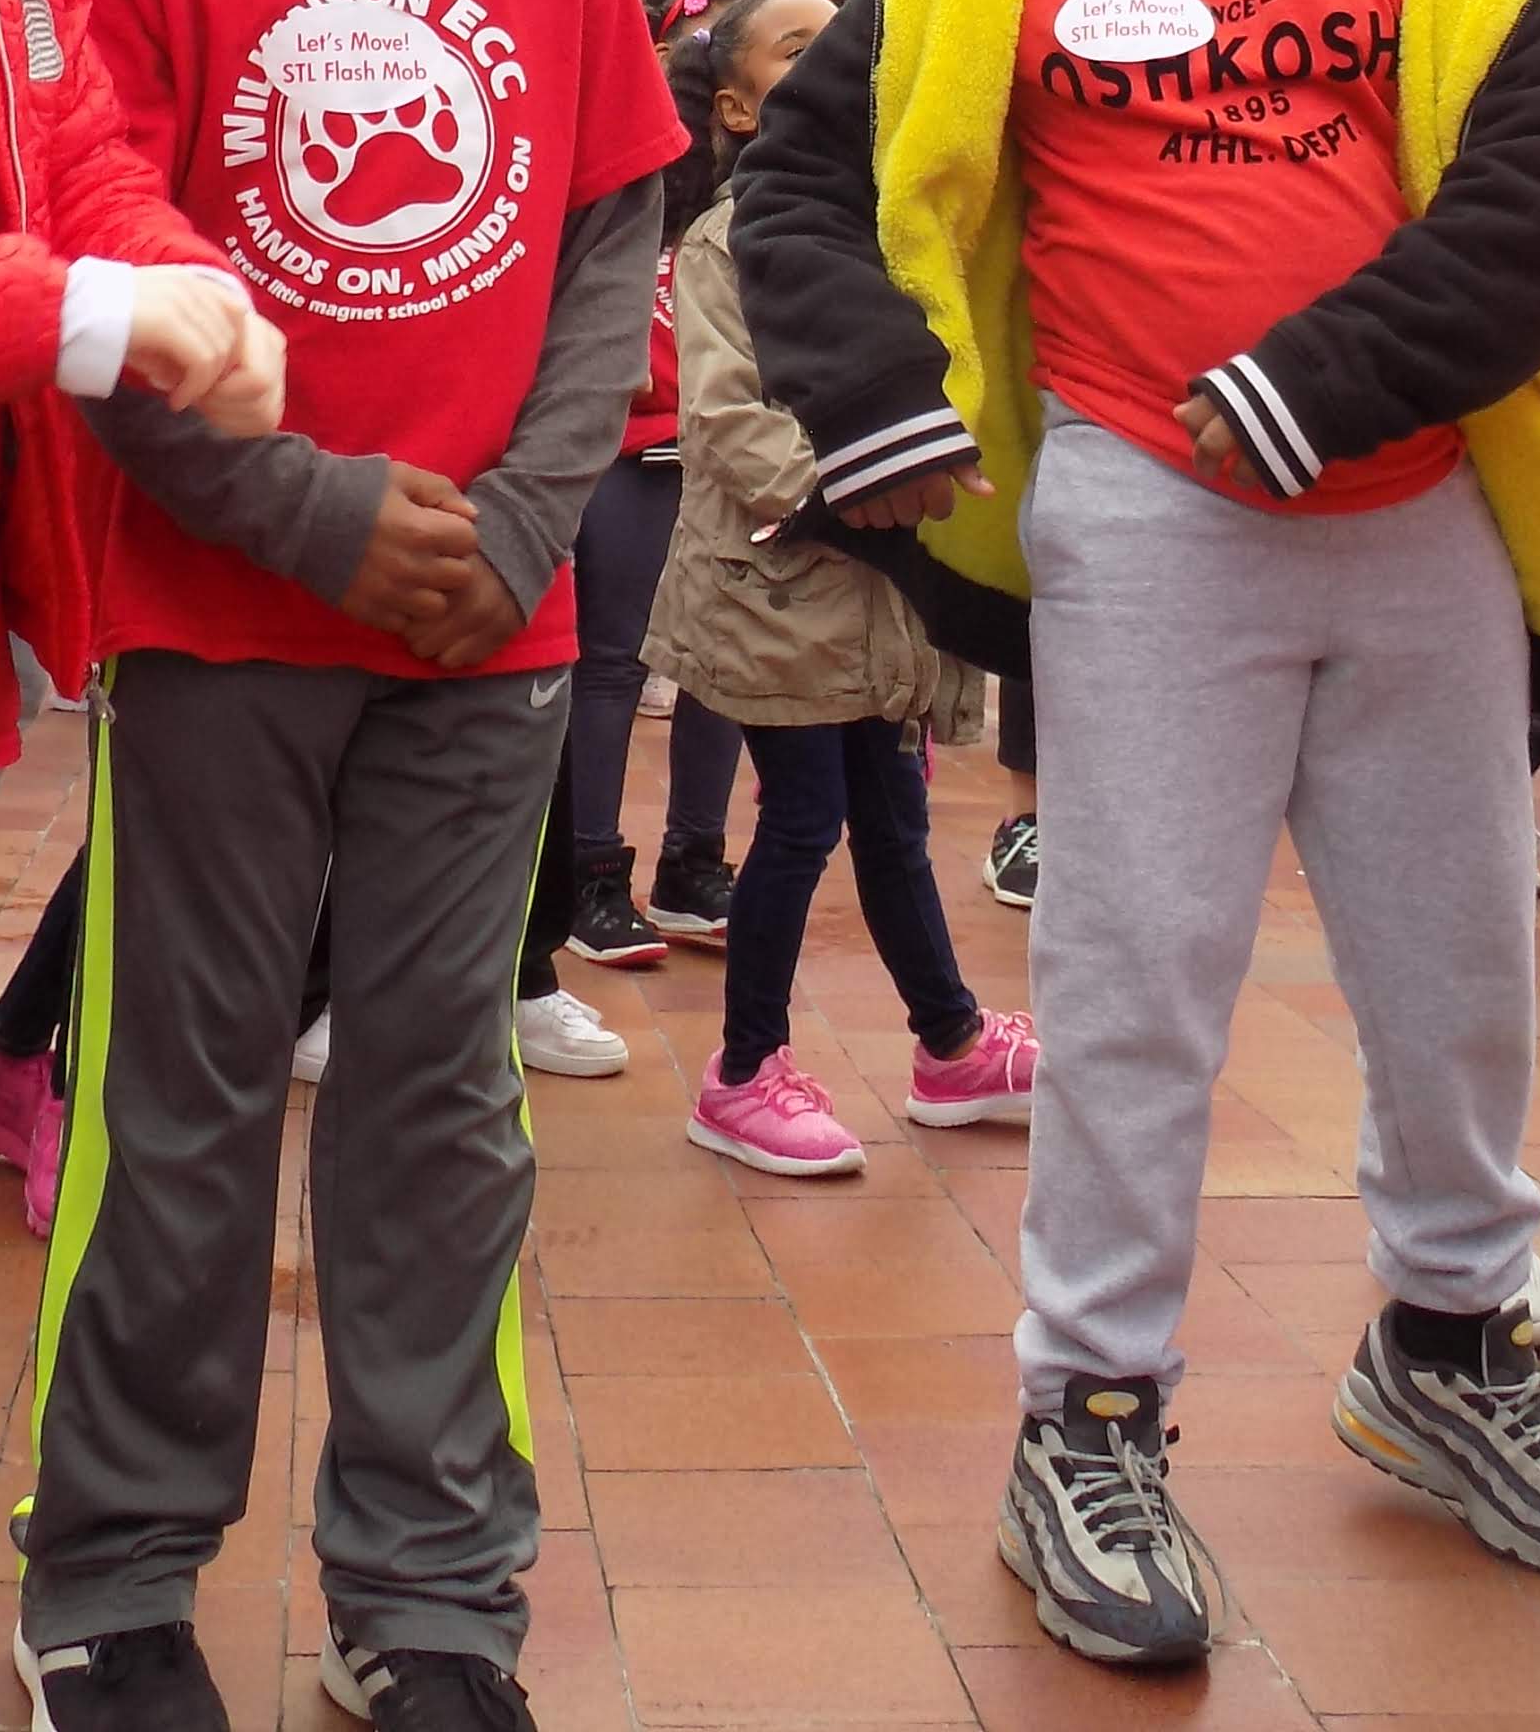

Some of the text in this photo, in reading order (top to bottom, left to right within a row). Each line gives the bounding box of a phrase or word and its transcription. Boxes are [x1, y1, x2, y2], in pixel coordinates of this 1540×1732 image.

[1083, 0, 1185, 18] Let's Move!
[296, 31, 410, 53] Let's Move!
[1070, 20, 1200, 44] STL Flash Mob
[282, 59, 428, 84] STL Flash Mob
[1205, 89, 1291, 130] 1895
[1159, 131, 1276, 164] ATHL.
[235, 135, 532, 297] HANDS ON, MINDS ON
[224, 235, 527, 323] a great little magnet school at slps.org
